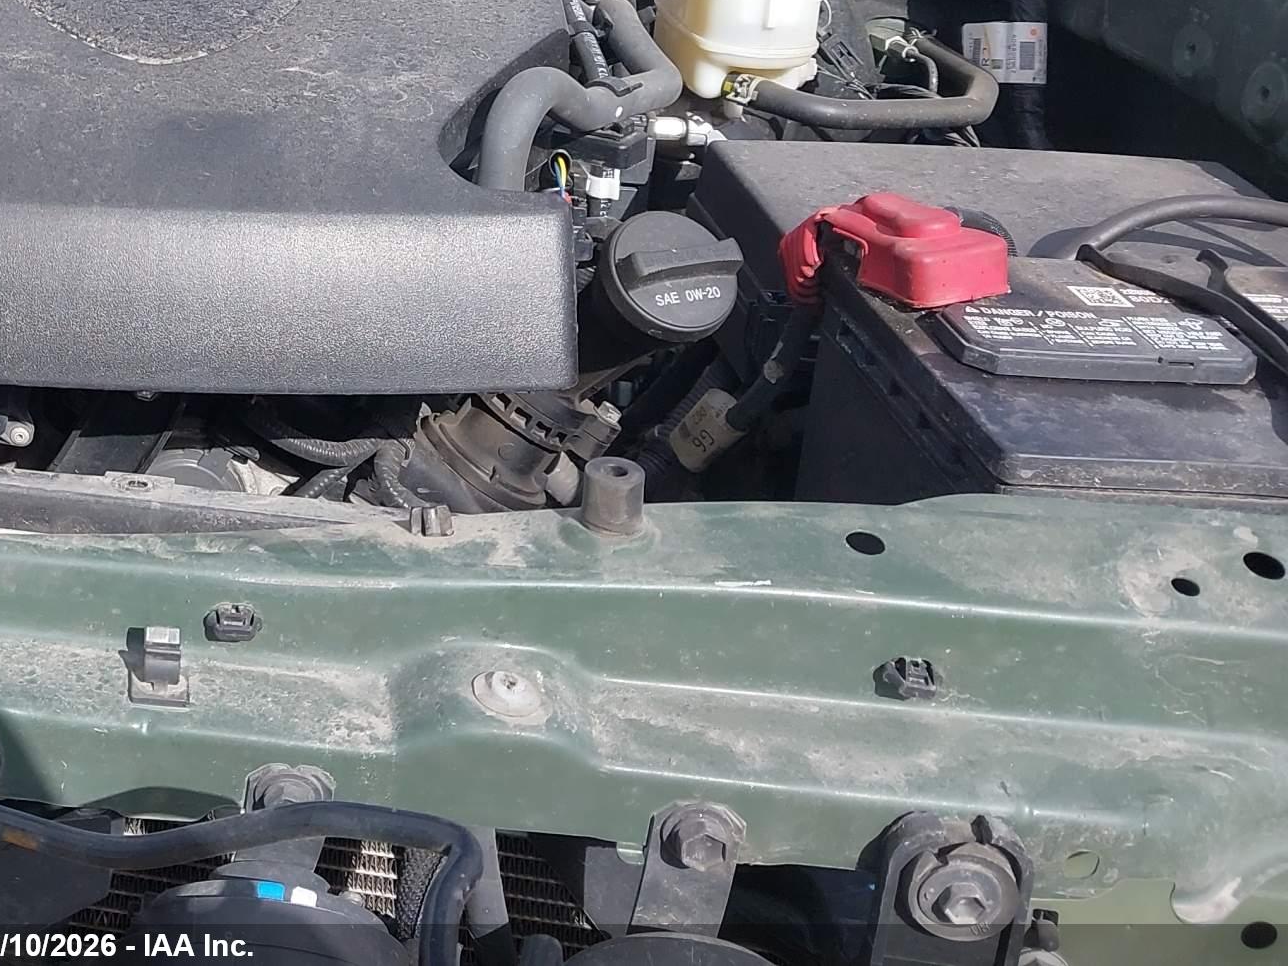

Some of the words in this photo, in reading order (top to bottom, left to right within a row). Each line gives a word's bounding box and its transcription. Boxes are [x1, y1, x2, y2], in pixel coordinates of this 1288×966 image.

[655, 292, 681, 307] SAE
[685, 286, 721, 303] 0W-20
[978, 306, 1035, 317] DANGER
[1044, 310, 1098, 319] POISON
